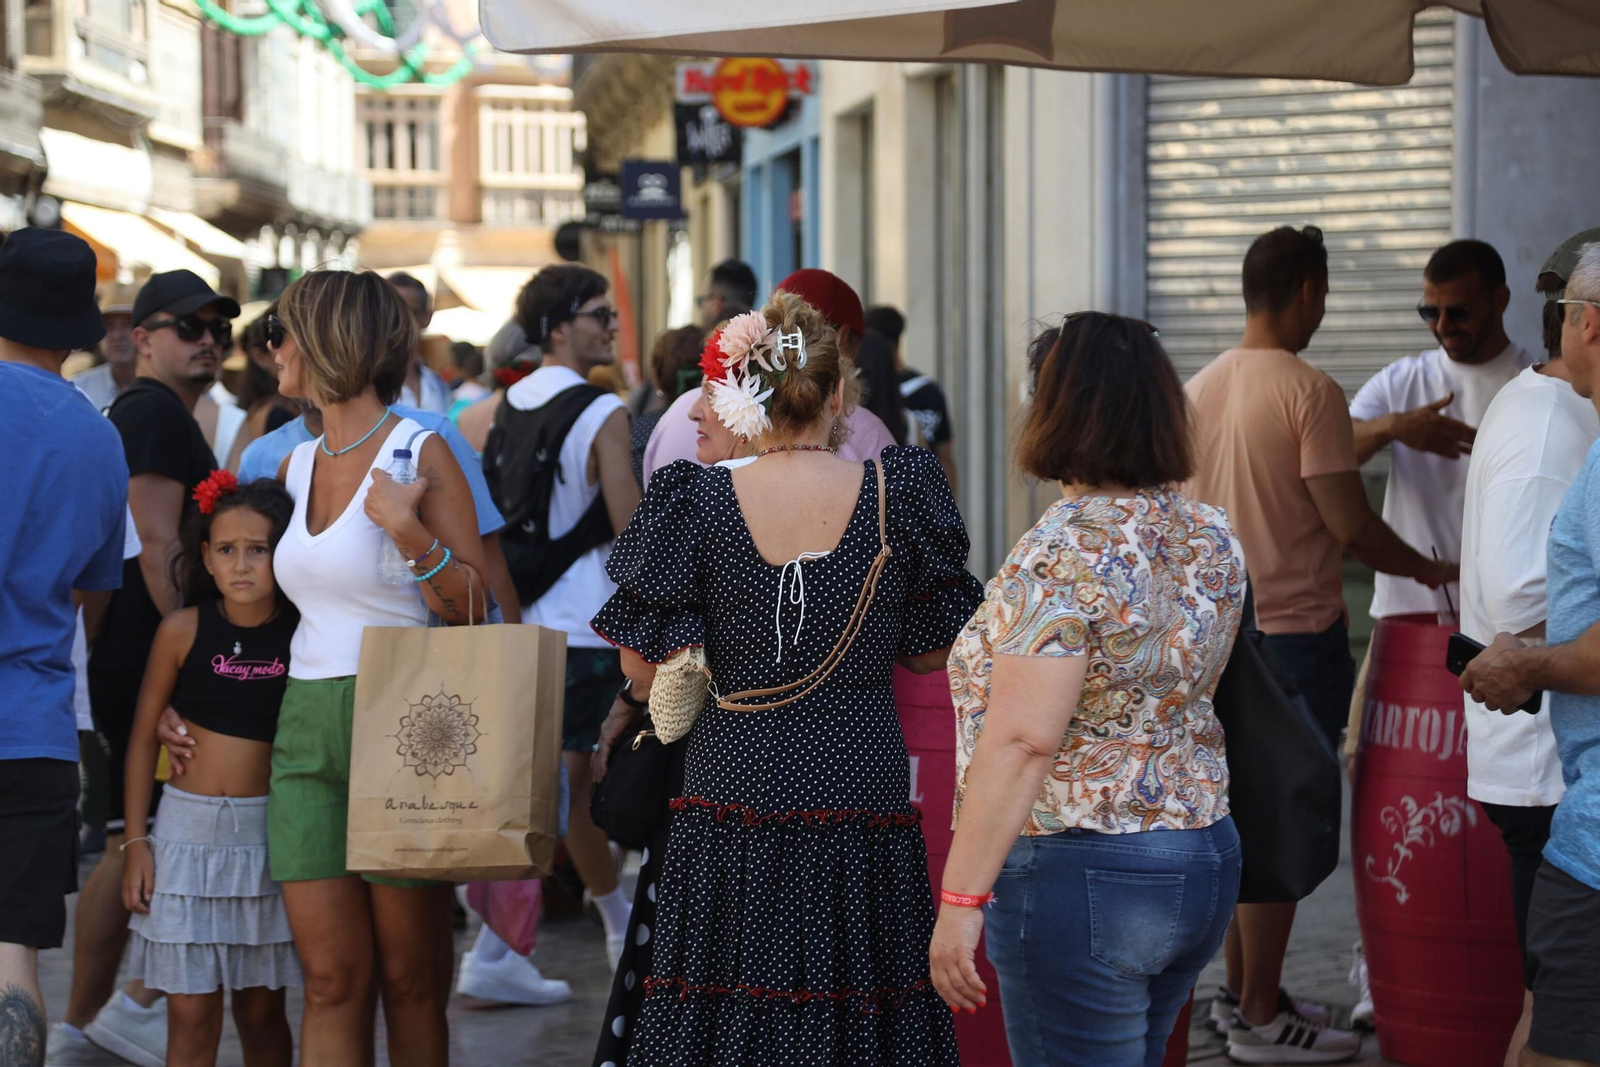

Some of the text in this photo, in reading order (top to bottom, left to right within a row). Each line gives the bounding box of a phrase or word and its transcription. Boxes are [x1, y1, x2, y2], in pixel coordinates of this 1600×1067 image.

[211, 654, 285, 681] Vacay mode
[384, 795, 479, 814] arabesque
